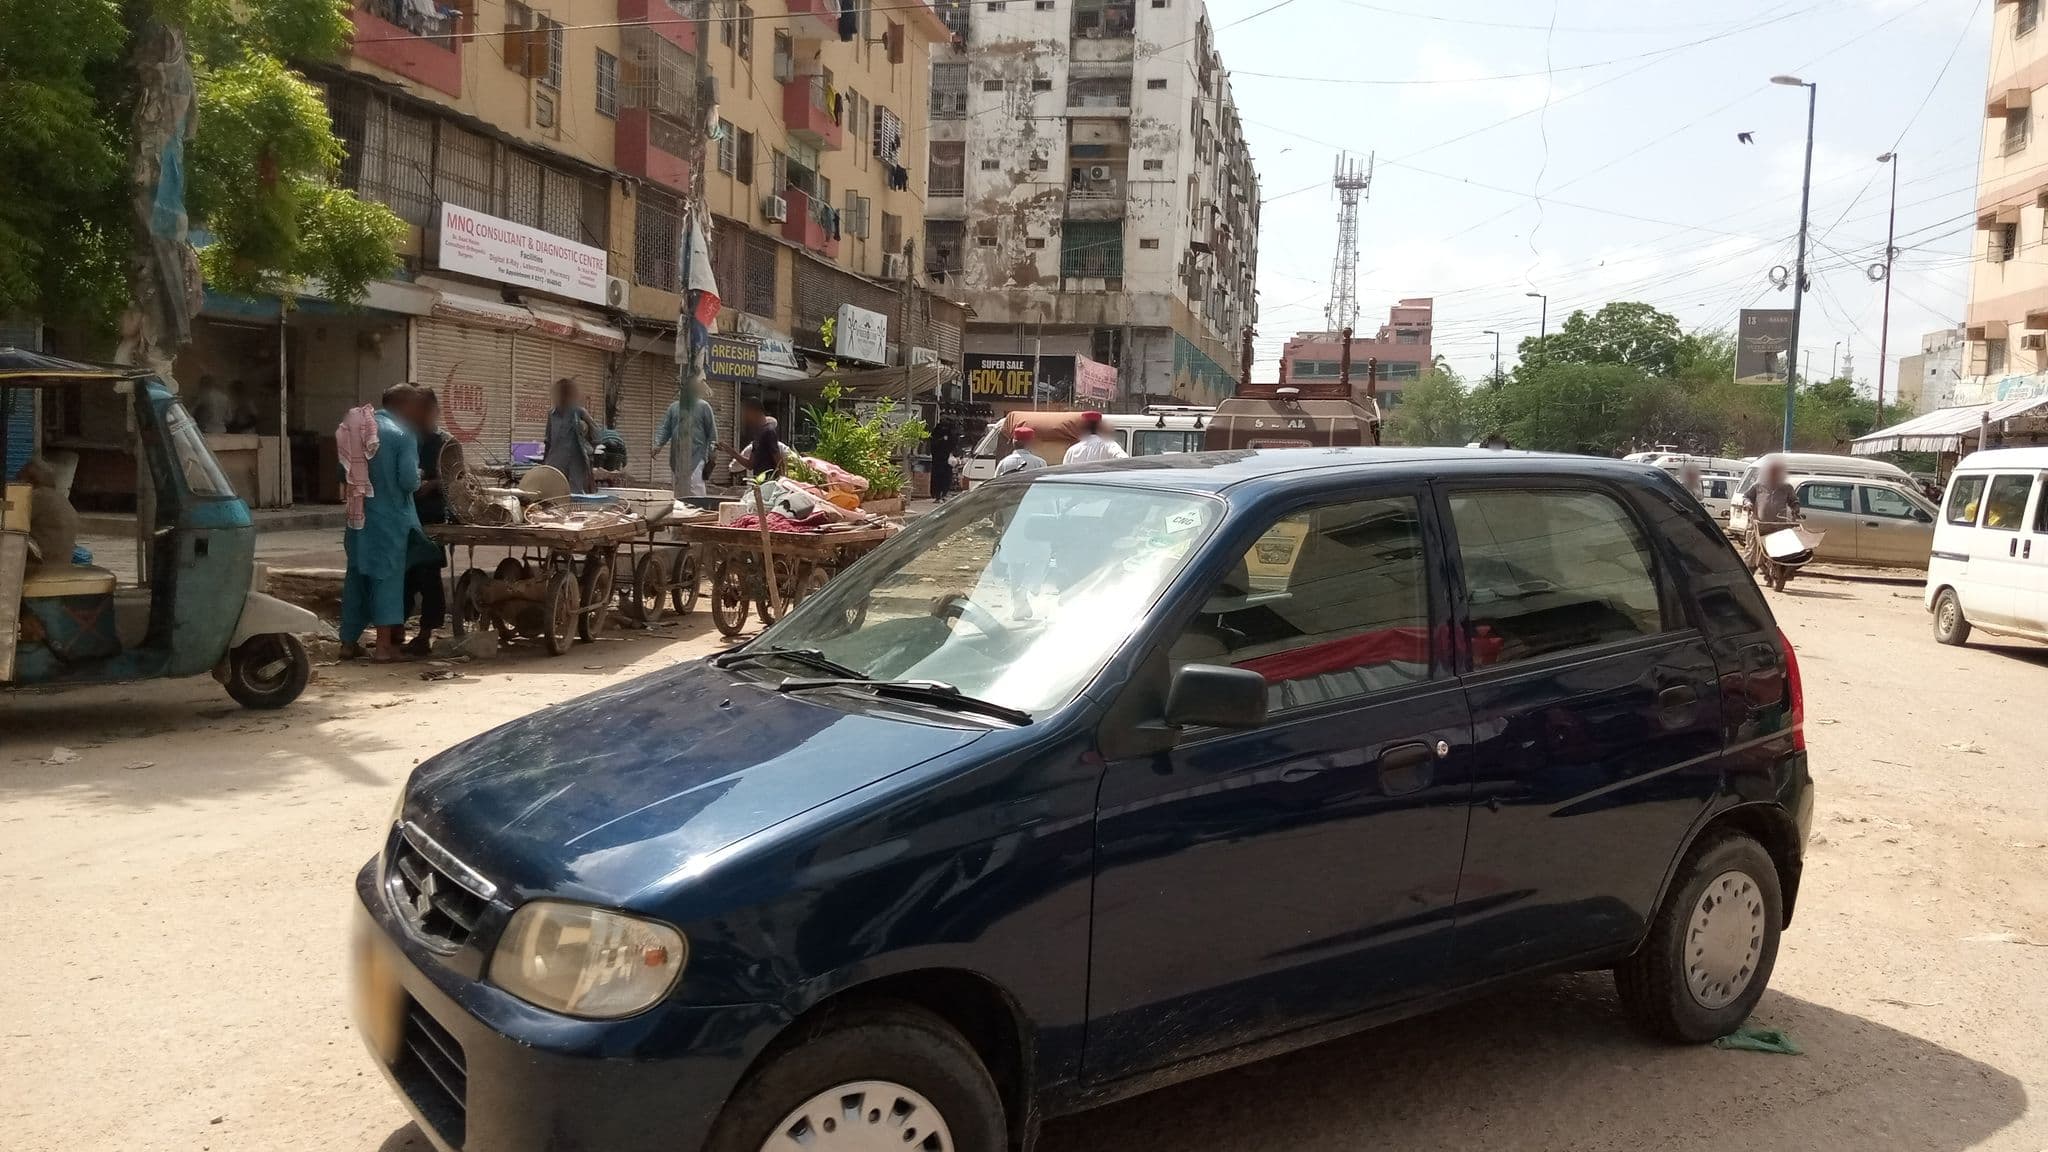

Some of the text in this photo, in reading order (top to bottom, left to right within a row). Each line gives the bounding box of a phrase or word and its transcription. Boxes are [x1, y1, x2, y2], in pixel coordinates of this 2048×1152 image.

[447, 212, 475, 237] MNQ
[476, 223, 526, 248] CONSULTANT
[527, 237, 534, 250] &
[535, 240, 579, 263] DIAGNOSTIC
[579, 253, 604, 271] CENTRE
[711, 344, 756, 362] AREESHA
[711, 361, 755, 378] UNIFORM
[981, 360, 1025, 370] SUPER SALE
[971, 369, 1033, 395] 50% OFF
[1172, 516, 1194, 526] CNG
